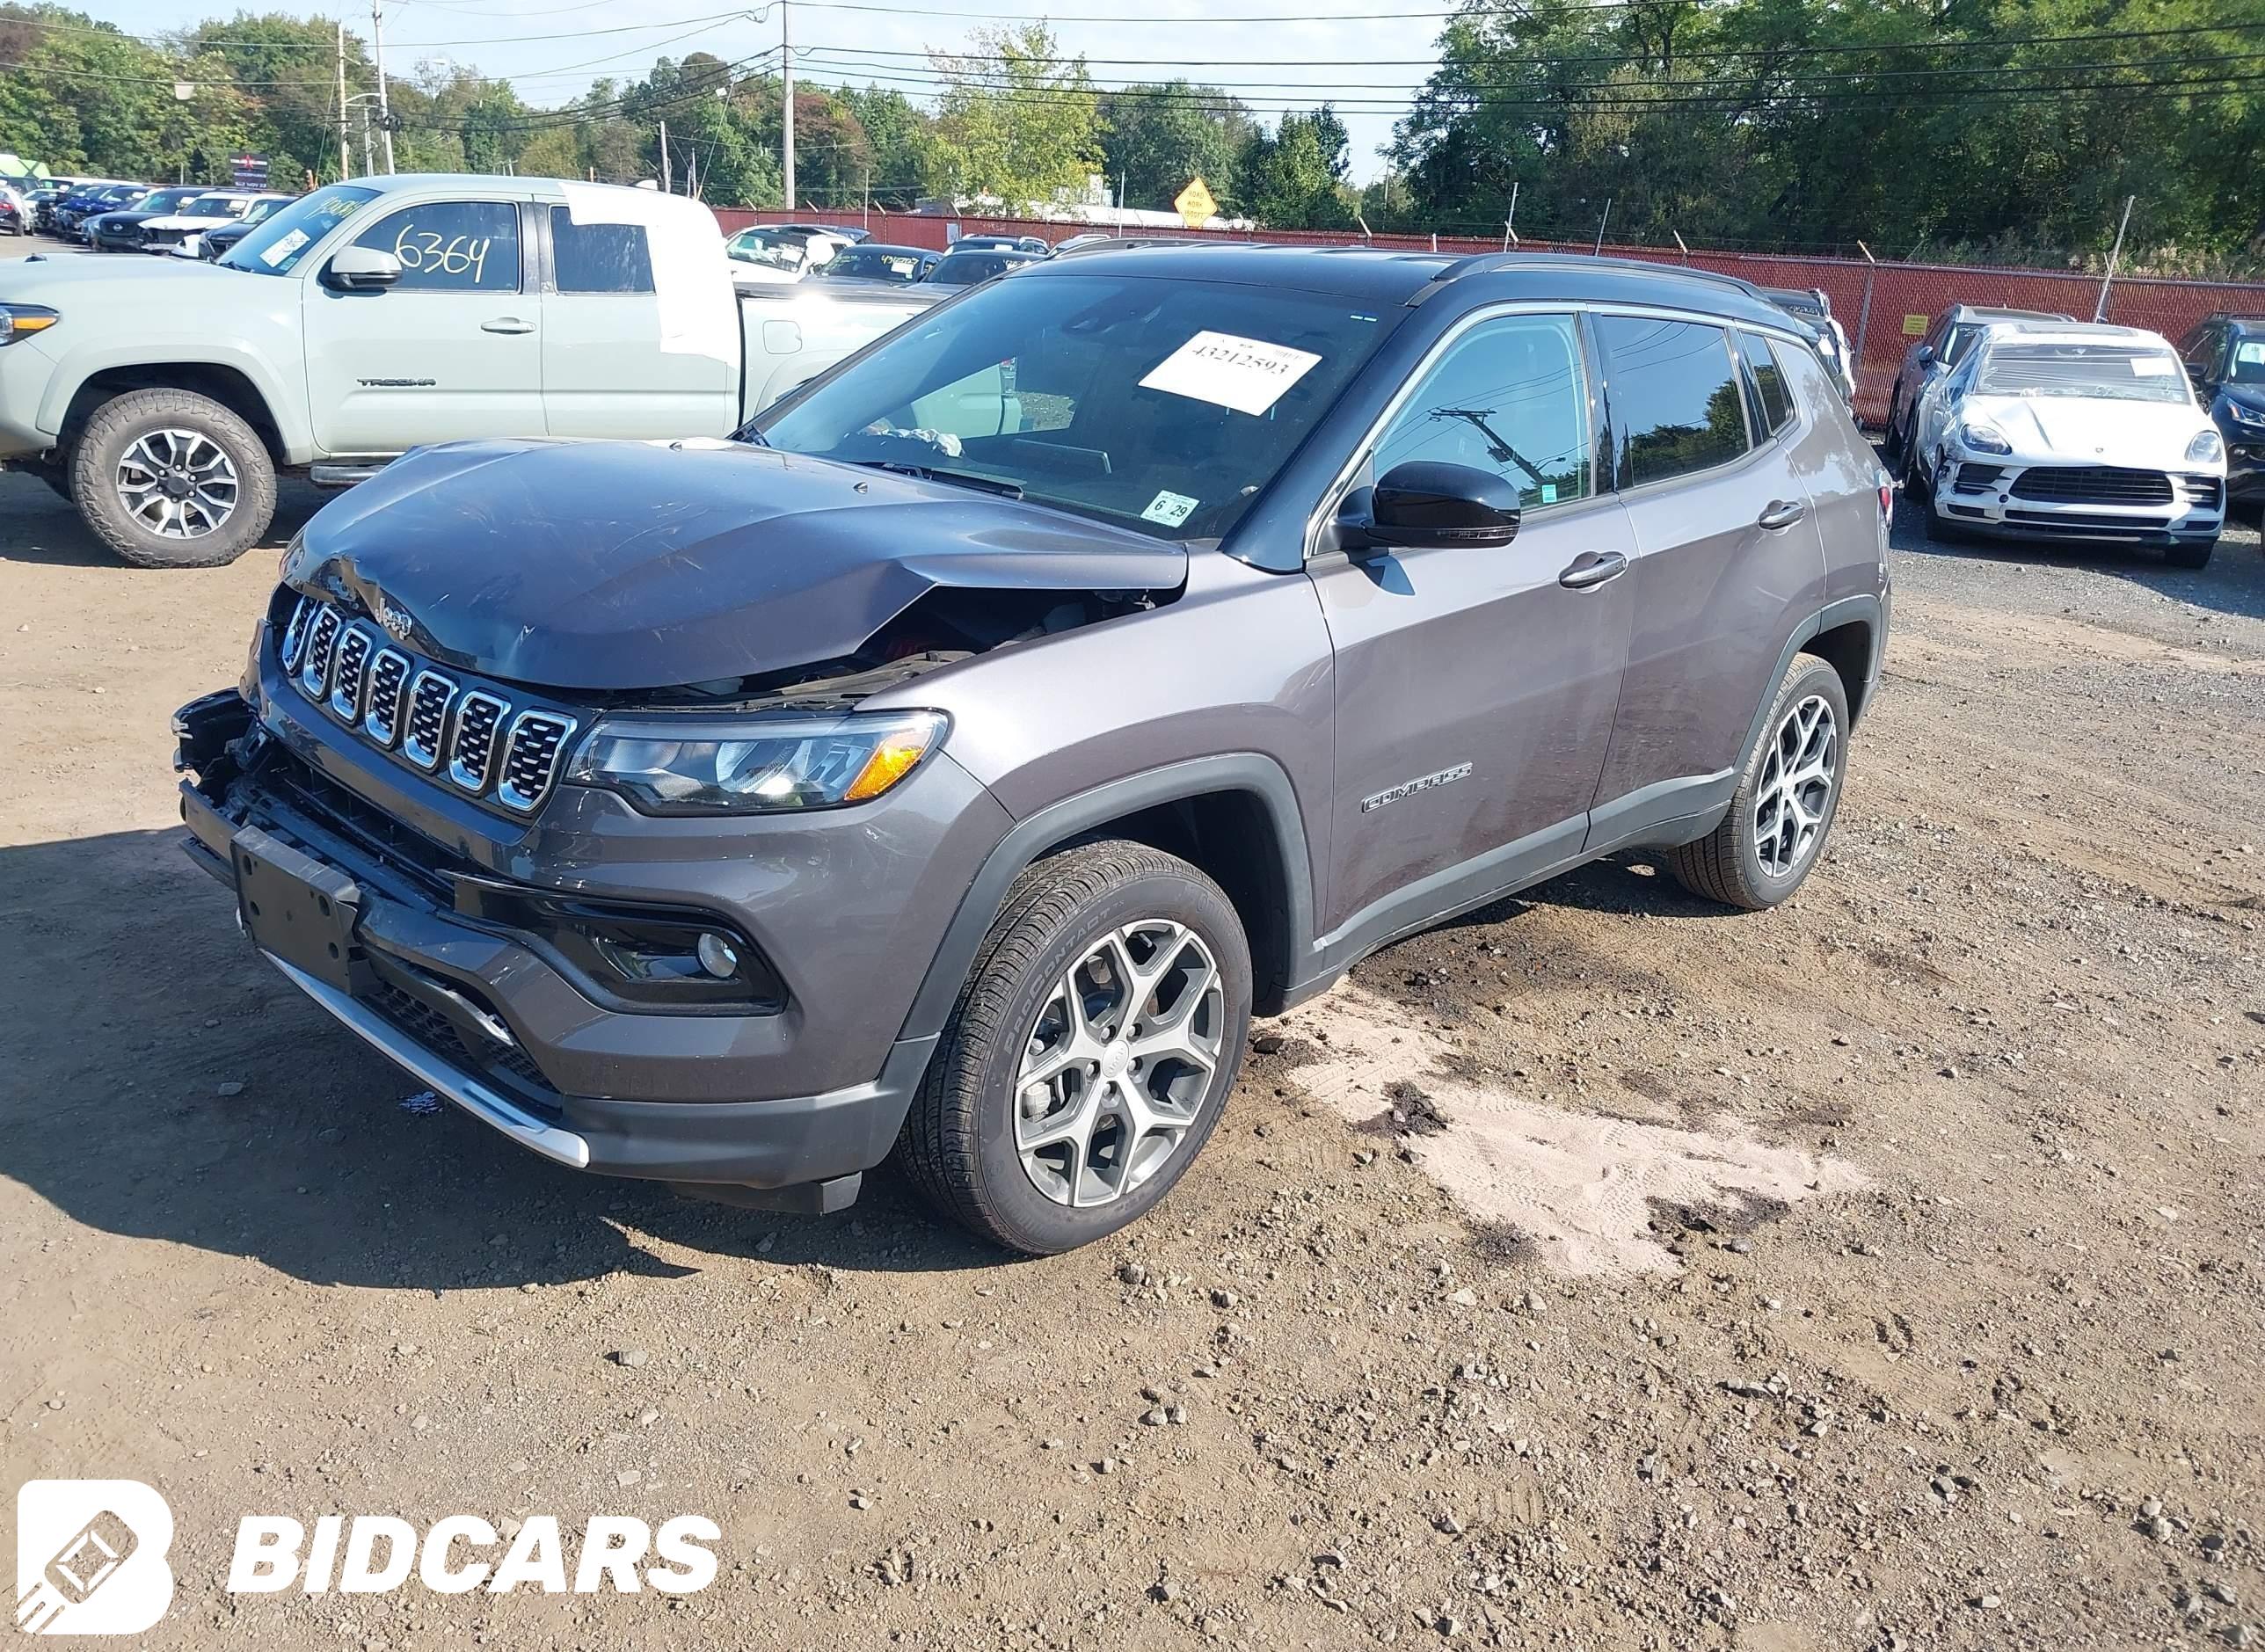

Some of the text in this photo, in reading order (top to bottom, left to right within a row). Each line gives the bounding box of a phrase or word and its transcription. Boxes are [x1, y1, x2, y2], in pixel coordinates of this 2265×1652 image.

[395, 224, 490, 283] 6364
[1192, 346, 1290, 375] 43212593
[357, 378, 436, 387] TACOMA
[1154, 499, 1166, 511] 6
[1169, 505, 1188, 518] 29
[375, 597, 413, 641] Jeep
[1361, 761, 1474, 813] COMPASS
